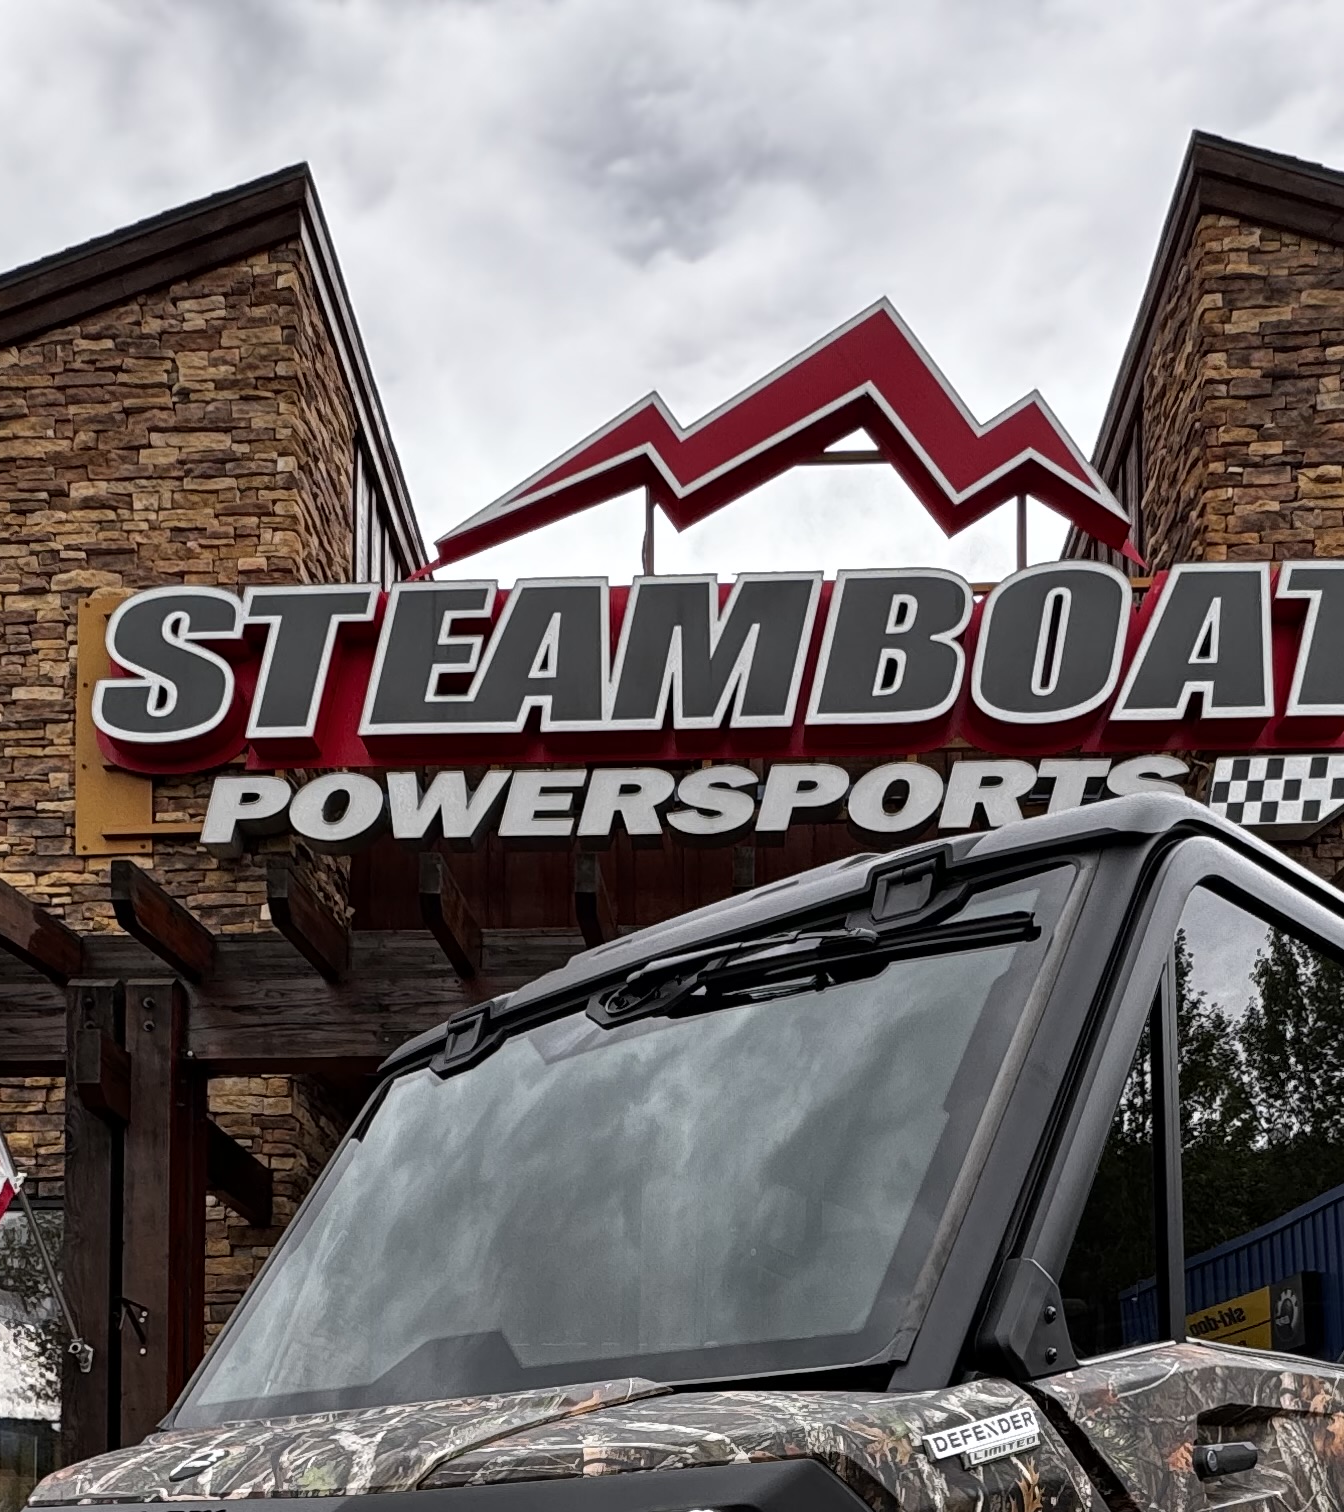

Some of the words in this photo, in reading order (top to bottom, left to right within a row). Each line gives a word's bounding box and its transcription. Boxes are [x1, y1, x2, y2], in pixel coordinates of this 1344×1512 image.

[199, 754, 1190, 846] POWERSPORTS
[933, 1410, 1035, 1453] DEFENDER
[973, 1436, 1036, 1461] LIMITED
